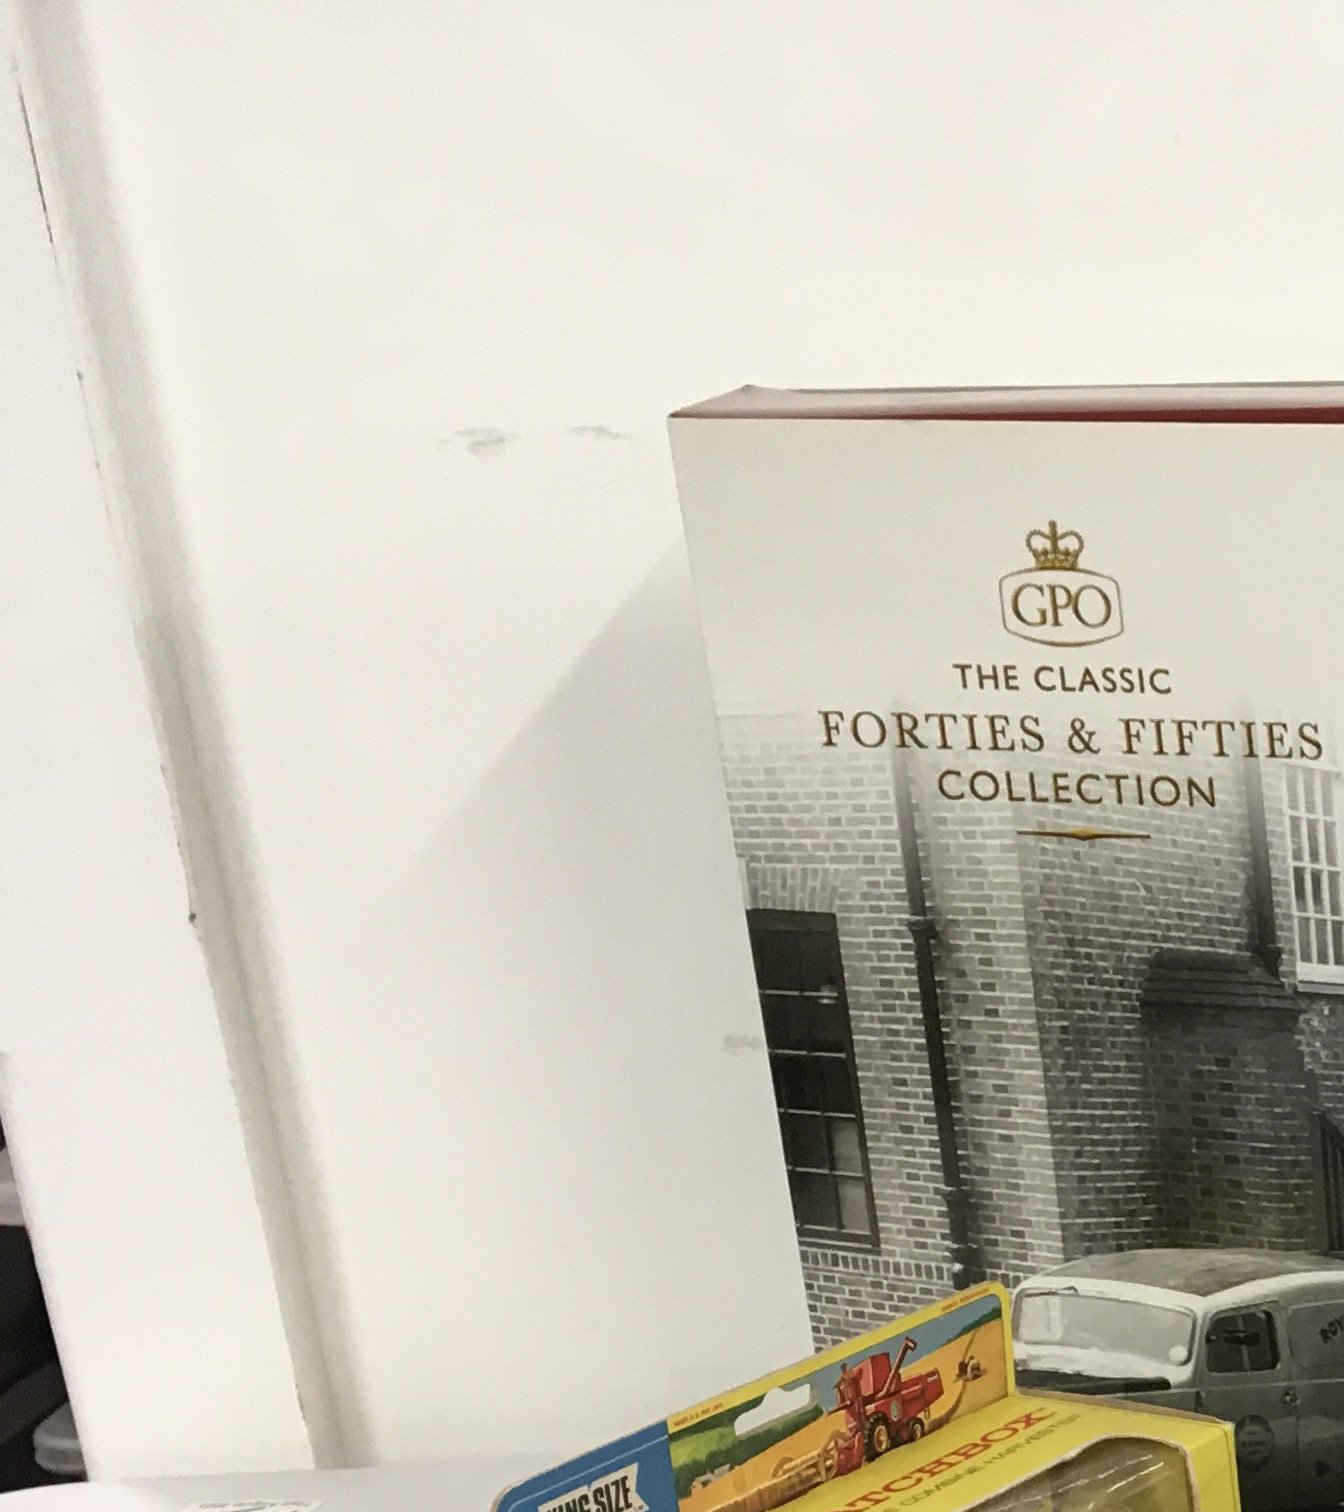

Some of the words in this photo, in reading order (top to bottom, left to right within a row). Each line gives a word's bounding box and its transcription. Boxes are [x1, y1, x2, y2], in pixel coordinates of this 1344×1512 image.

[1011, 584, 1112, 628] GPO
[952, 663, 1019, 692] THE
[1034, 665, 1172, 694] CLASSIC
[819, 711, 1045, 753] FORTIES
[1068, 719, 1101, 753] &
[1122, 719, 1324, 760] FIFTIES
[938, 771, 1216, 808] COLLECTION
